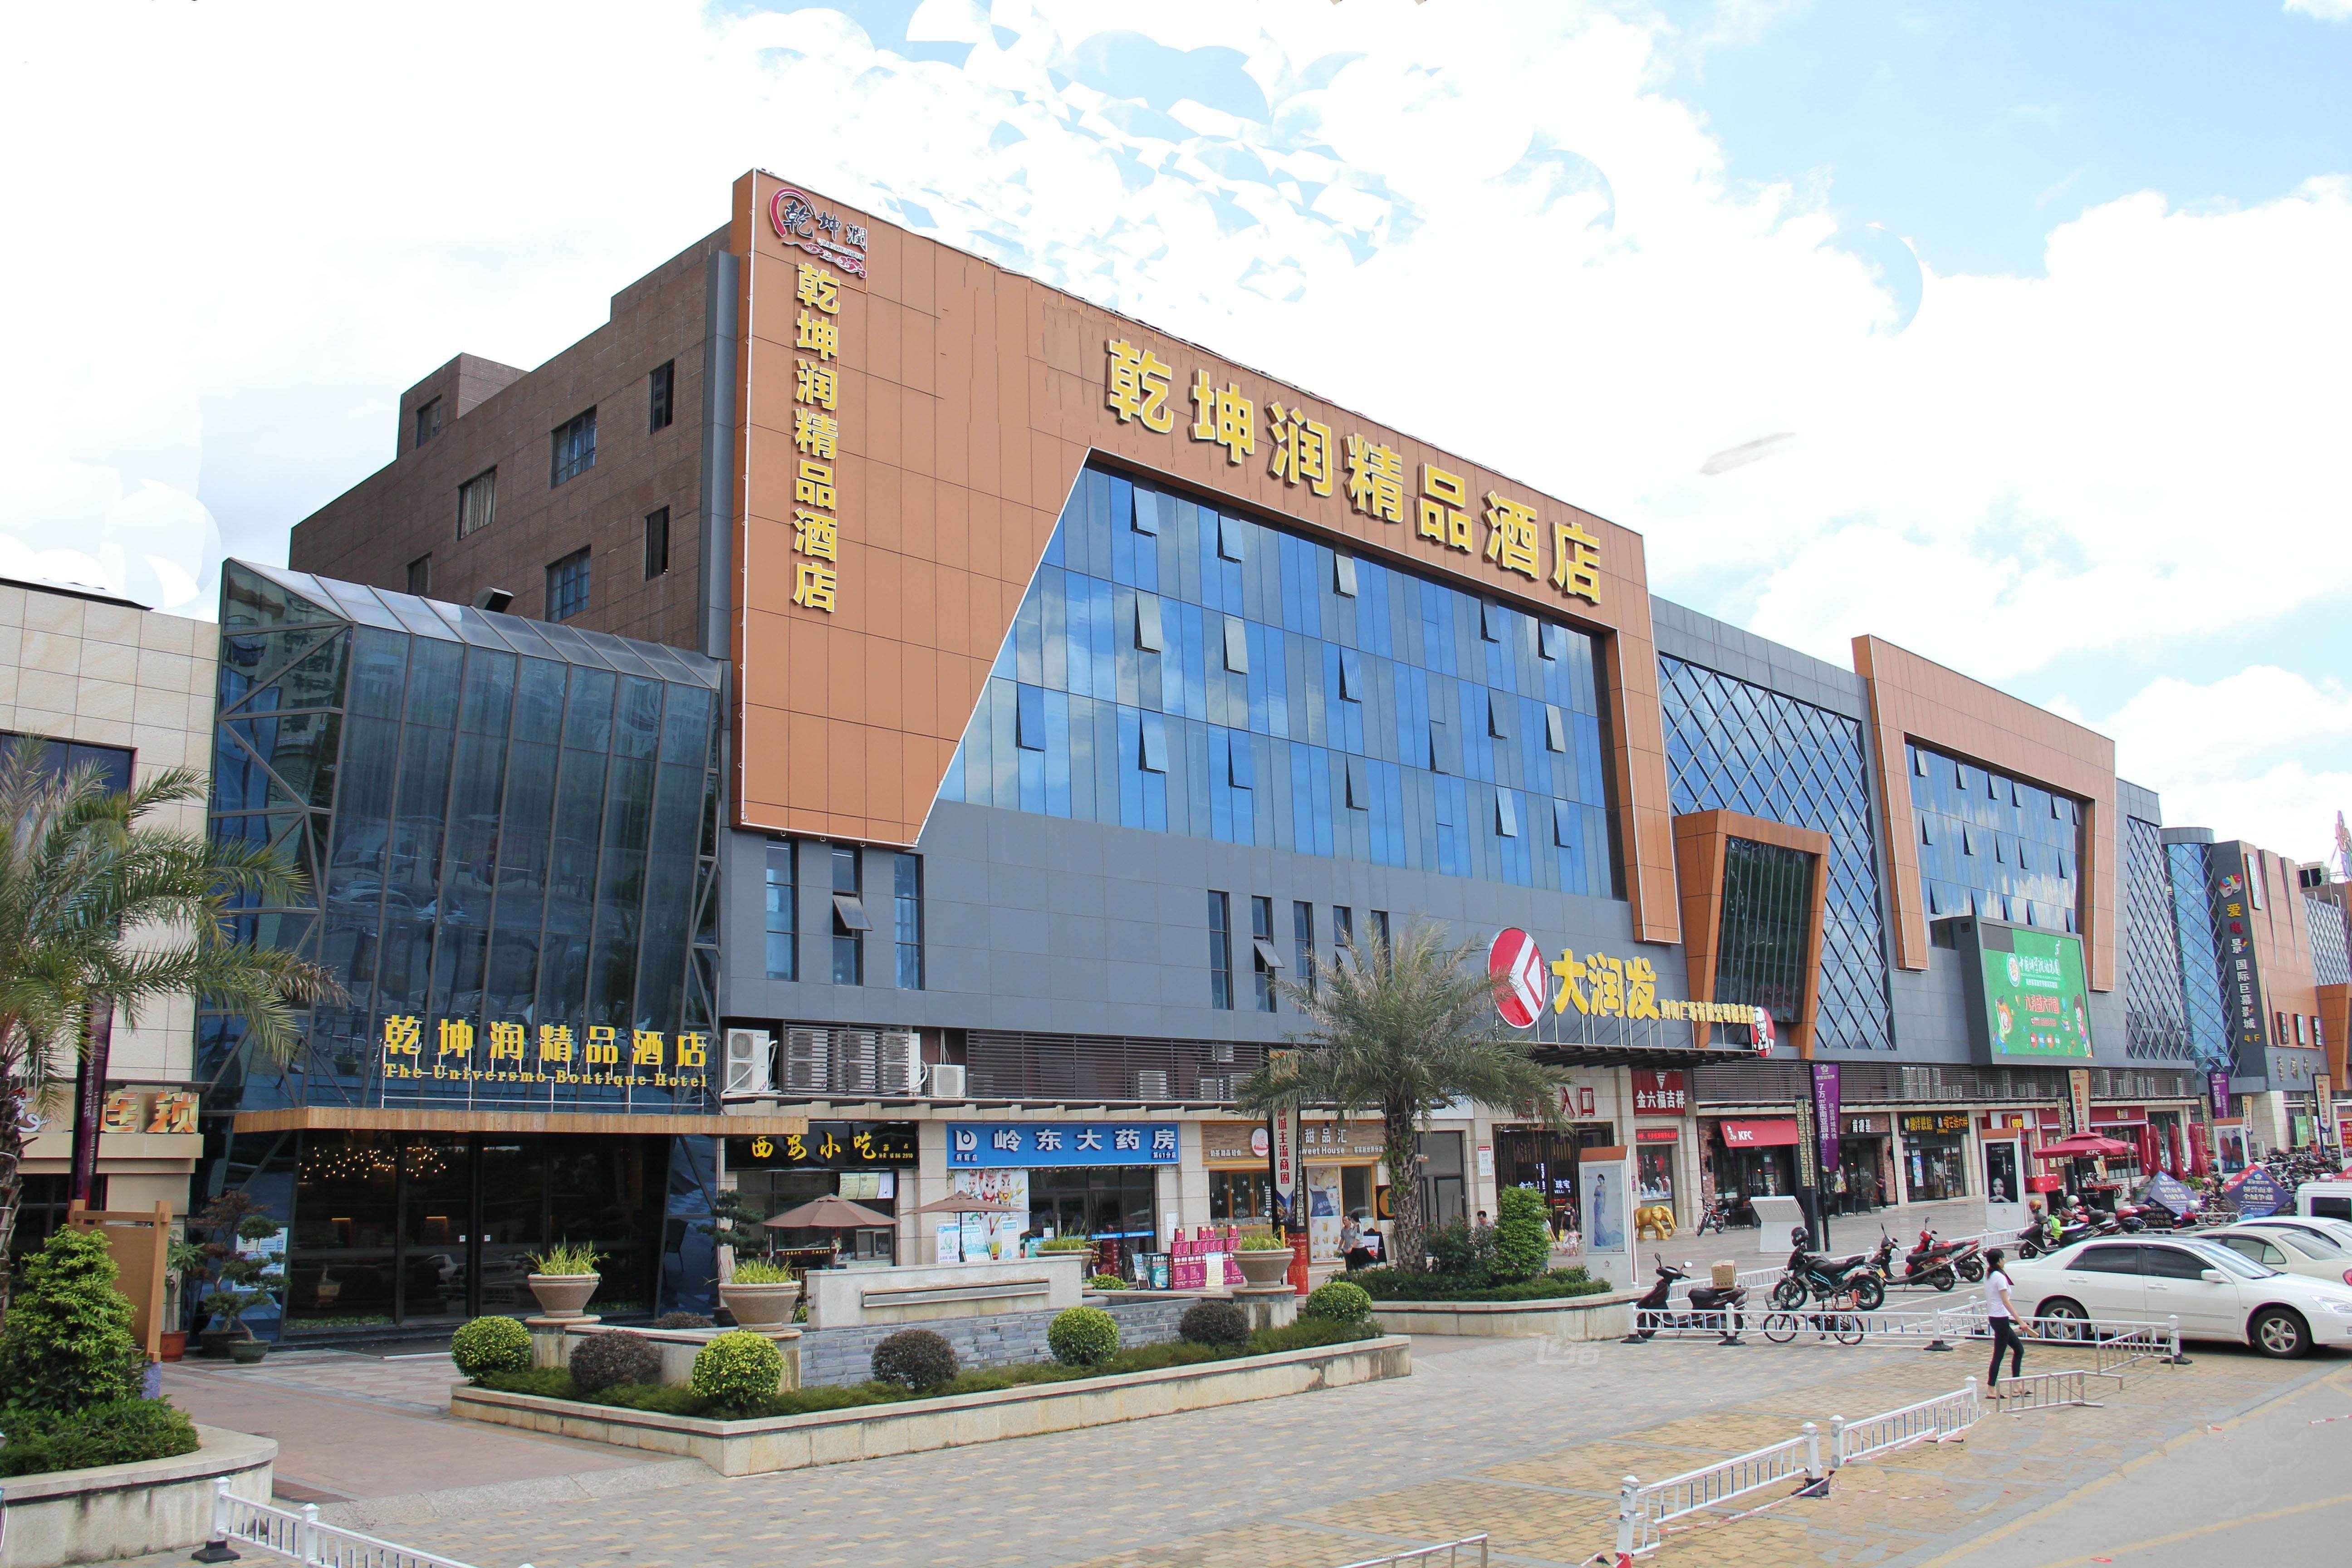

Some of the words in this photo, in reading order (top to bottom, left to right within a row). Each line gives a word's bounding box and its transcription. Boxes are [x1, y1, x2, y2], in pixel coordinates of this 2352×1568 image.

[792, 262, 841, 613] 乾坤润精品酒店
[1105, 338, 1602, 606] 乾坤润精品酒店
[1551, 948, 1660, 1020] 大润发
[385, 1014, 708, 1067] 乾坤润精品酒店
[384, 1063, 422, 1079] The
[555, 1070, 646, 1088] Boutique
[654, 1073, 708, 1088] Hotel
[1636, 1089, 1686, 1109] 金六福吉祥
[751, 1132, 877, 1161] 西安小吃
[994, 1128, 1176, 1152] 岭东大药房
[1305, 1128, 1348, 1144] 甜品汇
[1738, 1130, 1754, 1141] KFC
[956, 1153, 978, 1161] 府前店
[1302, 1147, 1319, 1155] weet
[1321, 1146, 1345, 1155] House
